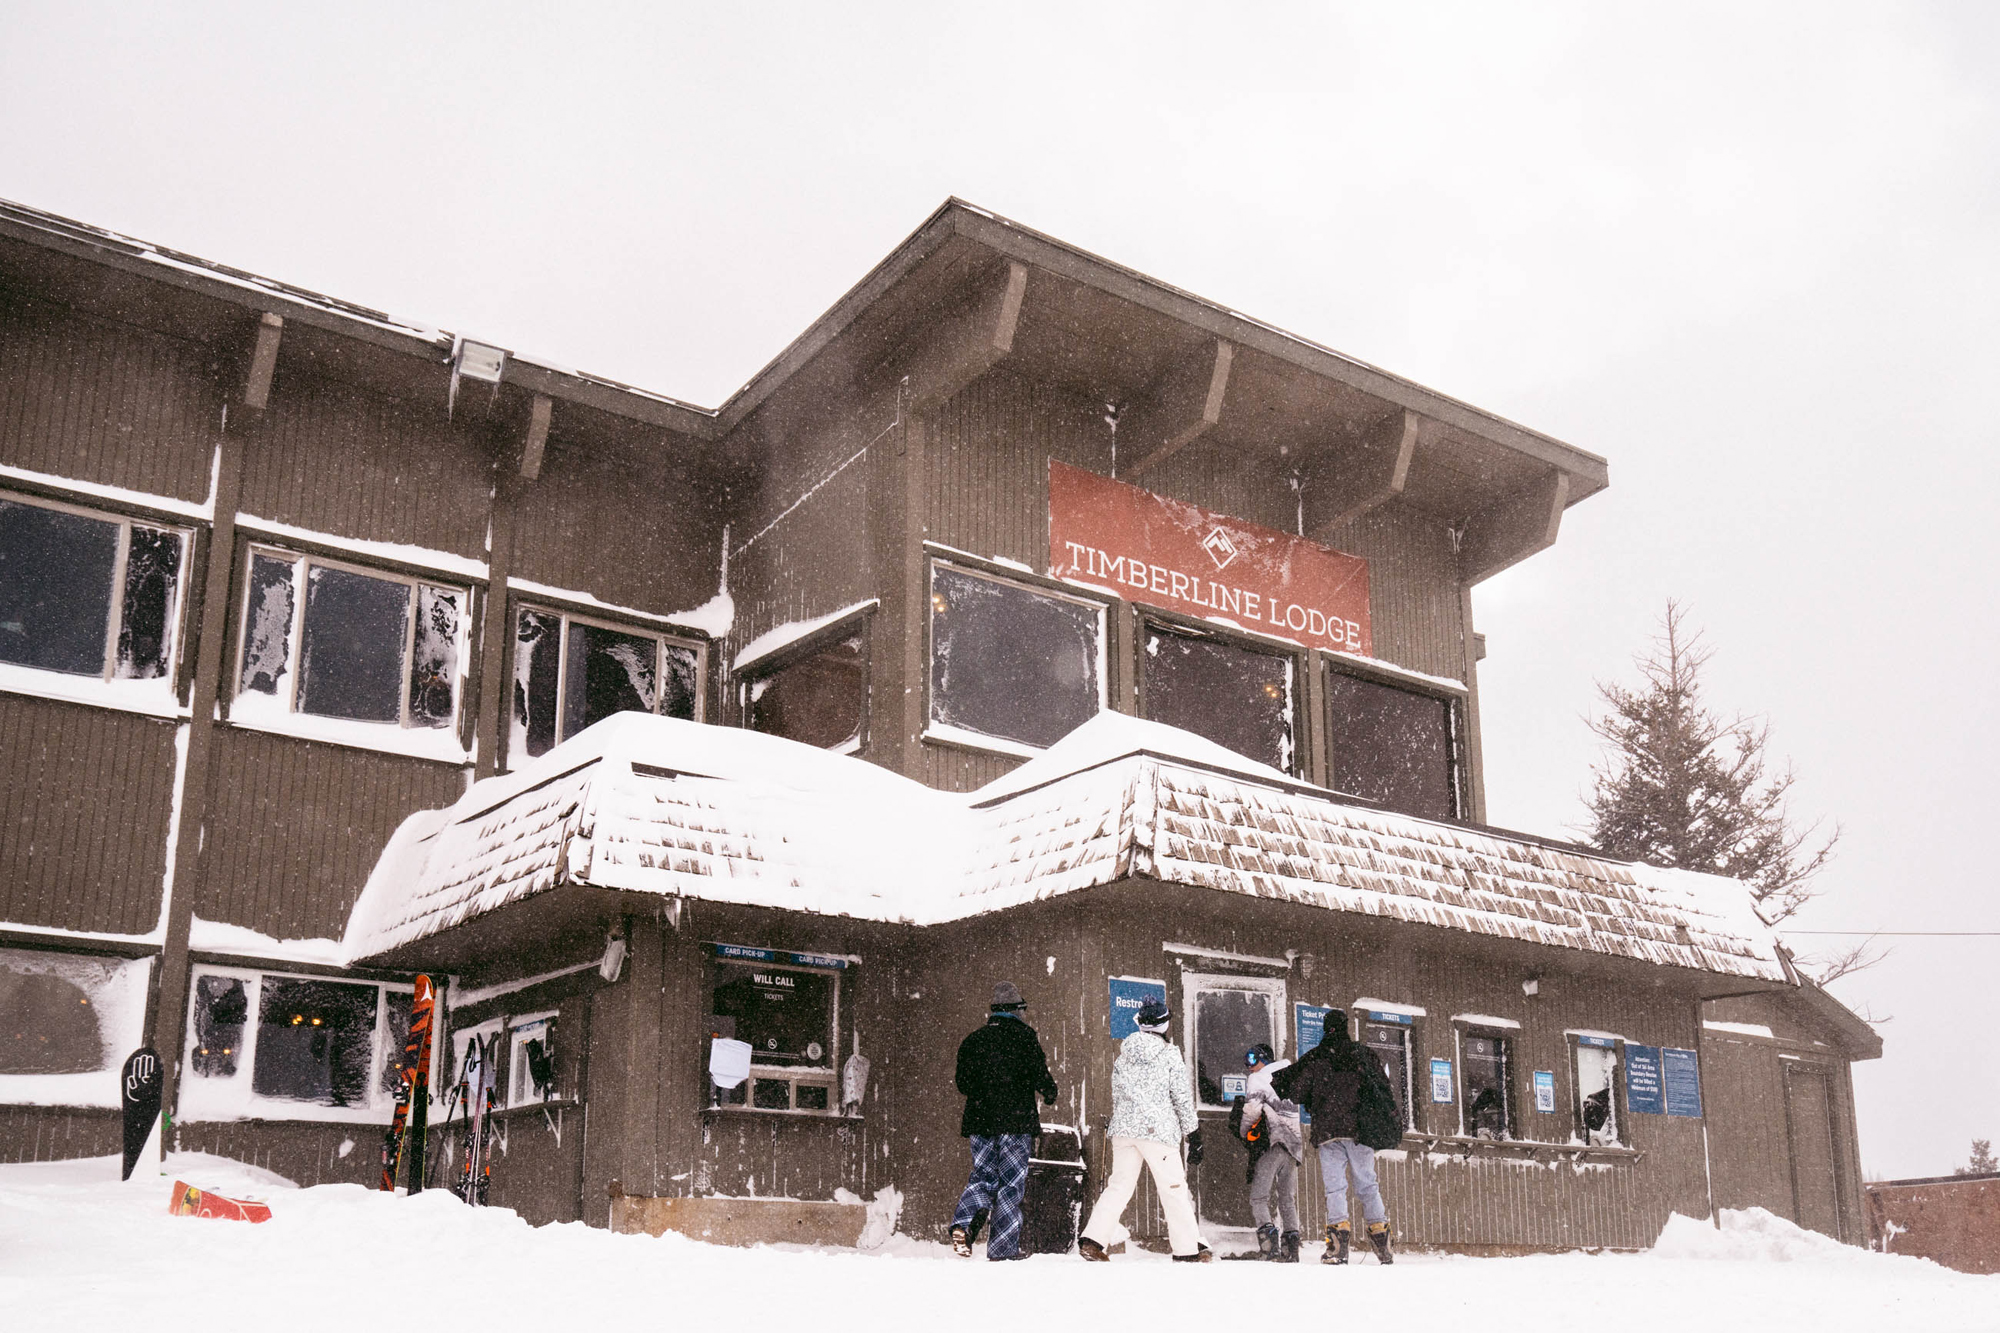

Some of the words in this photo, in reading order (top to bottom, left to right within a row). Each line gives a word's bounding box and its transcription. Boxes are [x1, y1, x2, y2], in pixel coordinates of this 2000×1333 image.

[1065, 541, 1262, 621] TIMBERLINE
[1269, 597, 1361, 649] LODGE
[725, 947, 741, 955] CARD
[742, 949, 765, 958] PICK-UP
[799, 955, 814, 963] CARD
[815, 957, 838, 966] PICK-UP
[753, 973, 773, 985] WILL
[775, 976, 795, 987] CALL
[764, 993, 784, 1001] TICKETS
[1116, 996, 1144, 1009] Restro
[1302, 1009, 1318, 1019] Ticket
[1382, 1013, 1400, 1022] TICKETS
